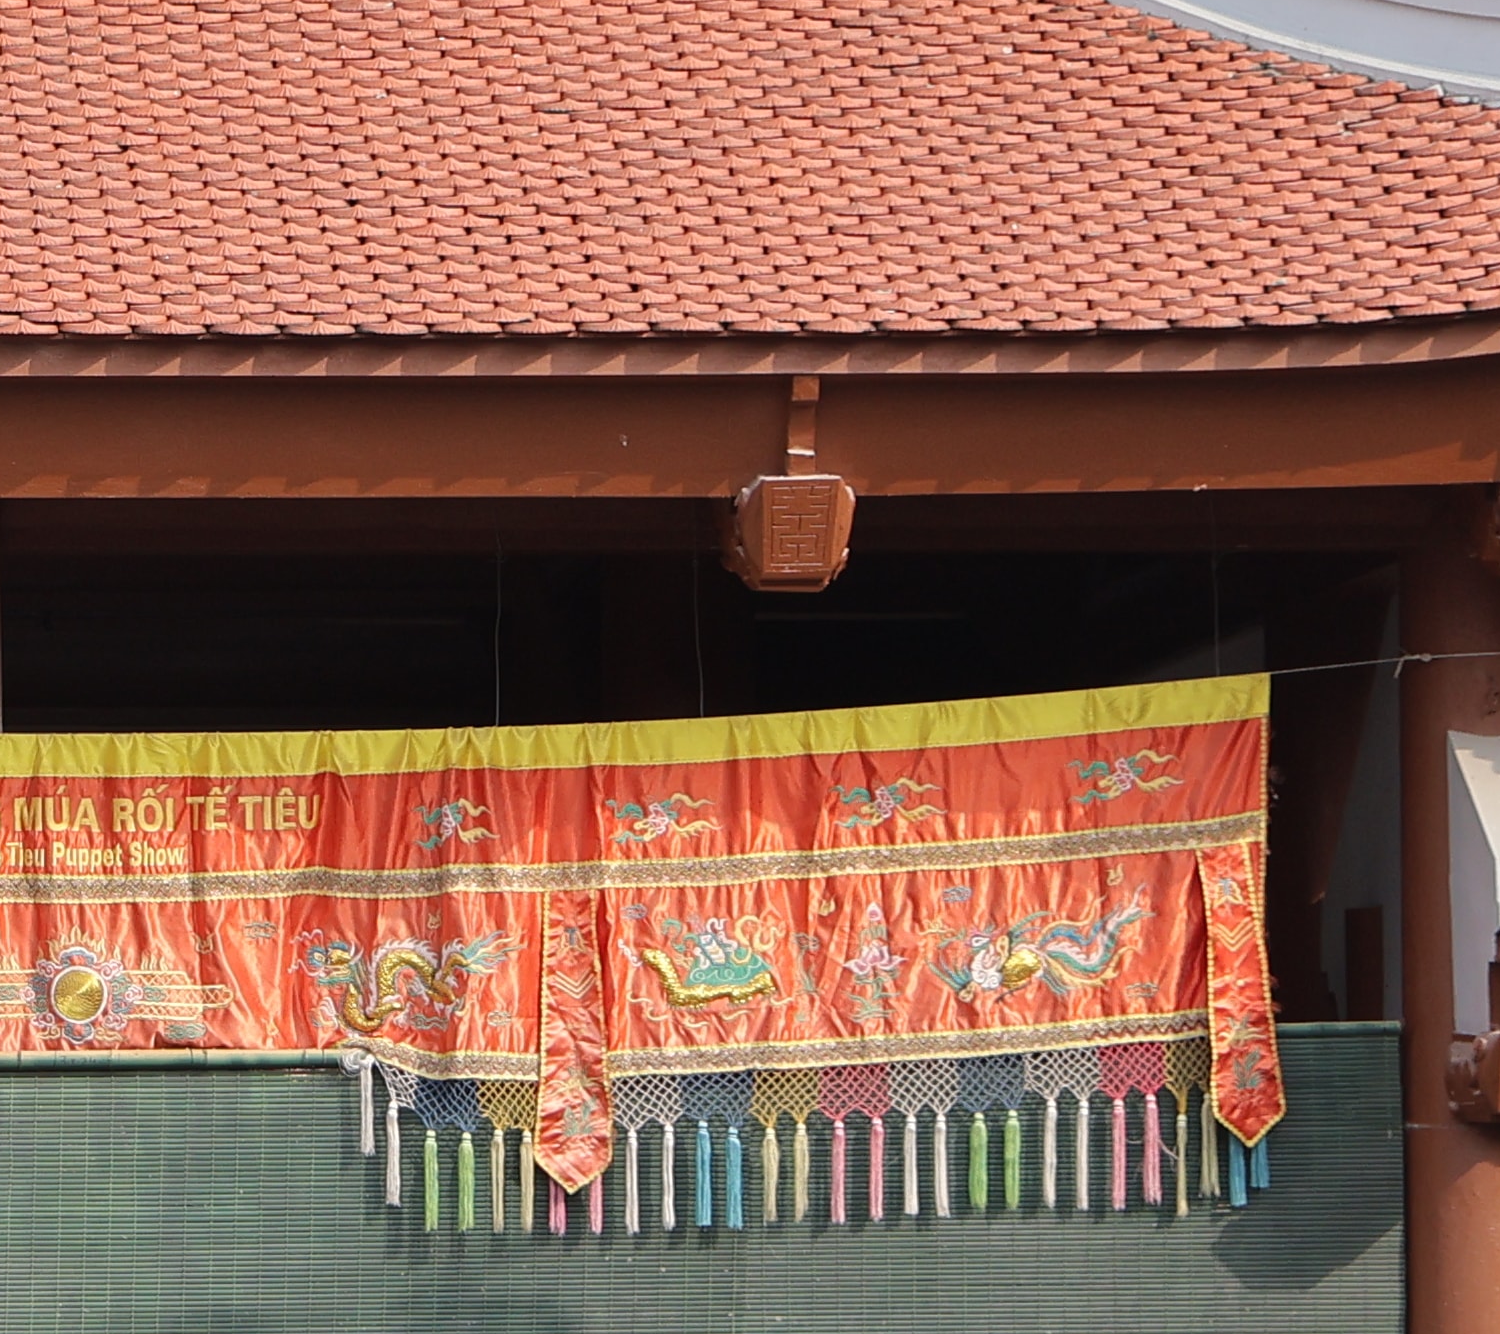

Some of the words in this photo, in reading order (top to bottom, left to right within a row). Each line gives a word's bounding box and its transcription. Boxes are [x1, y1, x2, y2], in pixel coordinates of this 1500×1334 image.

[14, 784, 101, 833] MÚA
[112, 784, 176, 833] RỐI
[186, 785, 235, 831] TẾ
[238, 786, 320, 831] TIÊU
[6, 841, 46, 868] Tieu
[52, 841, 123, 873] Puppet
[128, 840, 186, 868] Show
